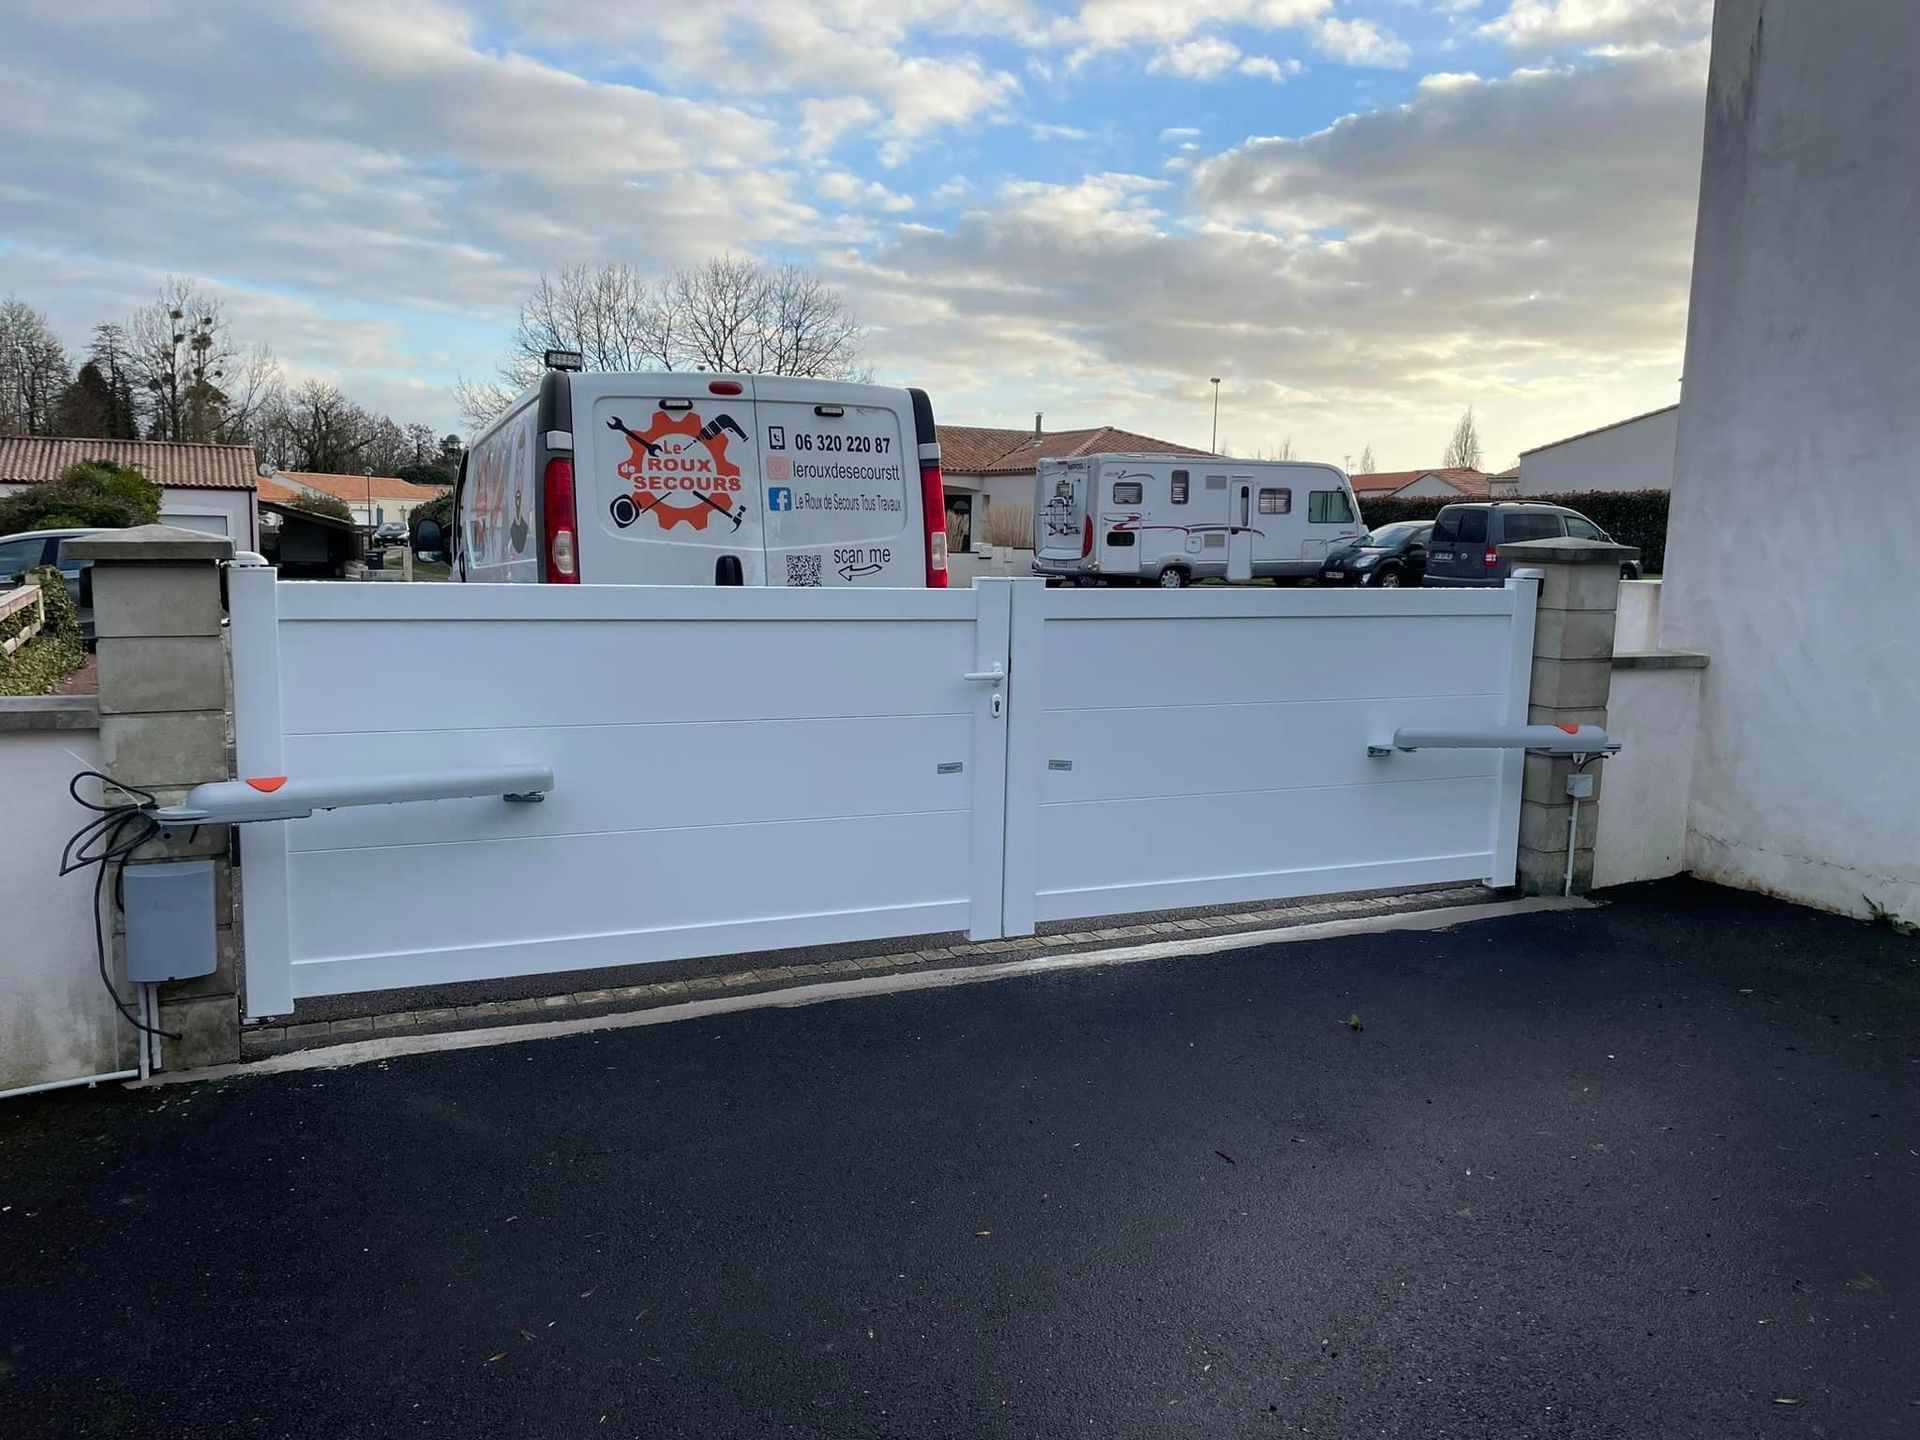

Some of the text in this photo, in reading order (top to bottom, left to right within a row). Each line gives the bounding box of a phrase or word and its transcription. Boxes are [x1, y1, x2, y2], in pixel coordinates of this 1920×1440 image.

[663, 440, 682, 455] Le
[795, 433, 890, 454] 06 320 220 87
[620, 462, 636, 475] de
[647, 458, 712, 472] ROUX
[792, 460, 900, 480] lerouxdesecourstt
[633, 475, 742, 491] SECOURS
[794, 493, 804, 509] Le
[804, 493, 822, 510] Roux
[823, 492, 832, 510] de
[833, 493, 860, 511] Secours
[860, 494, 876, 511] Tous
[833, 548, 891, 564] scan me
